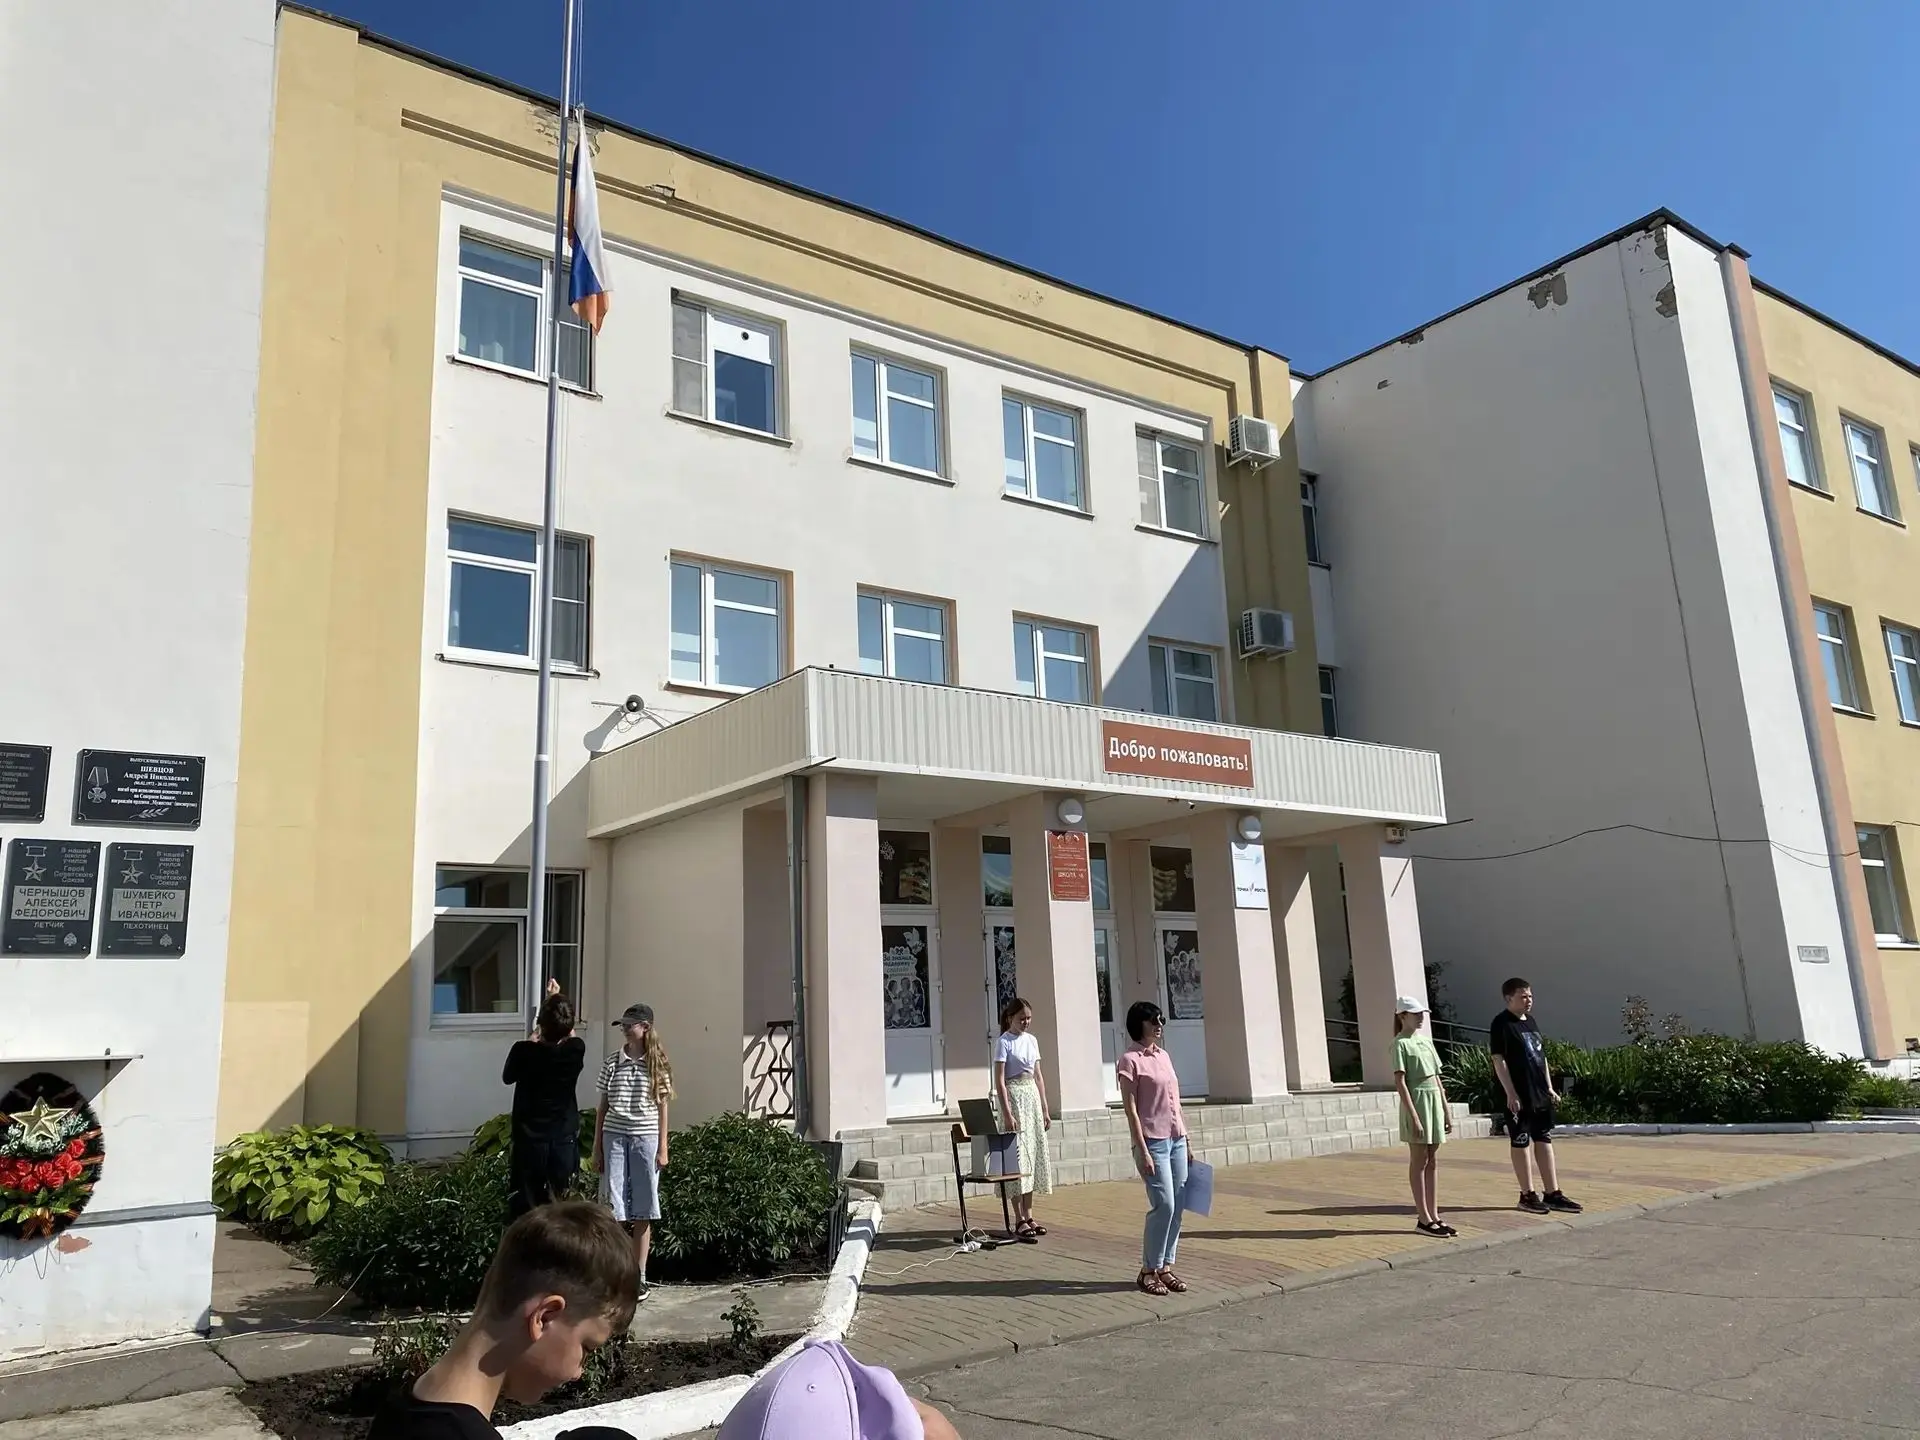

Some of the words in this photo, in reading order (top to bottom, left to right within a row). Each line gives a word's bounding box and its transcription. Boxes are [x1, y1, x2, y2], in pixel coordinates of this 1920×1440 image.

[1109, 737, 1156, 762] Добро
[1160, 748, 1249, 771] пожаловать!
[124, 772, 148, 780] Андрей
[150, 773, 190, 782] Николаевич
[19, 888, 86, 898] ЧЕРНЫШОВ
[122, 890, 176, 900] ШУМЕЙКО
[24, 898, 78, 908] АЛЕКСЕЙ
[134, 901, 162, 909] ПЕТР
[14, 908, 86, 918] ФЕДОРОВИЧ
[118, 910, 177, 919] ИВАНОВИЧ
[123, 922, 169, 930] ПЕХОТИНЕЦ
